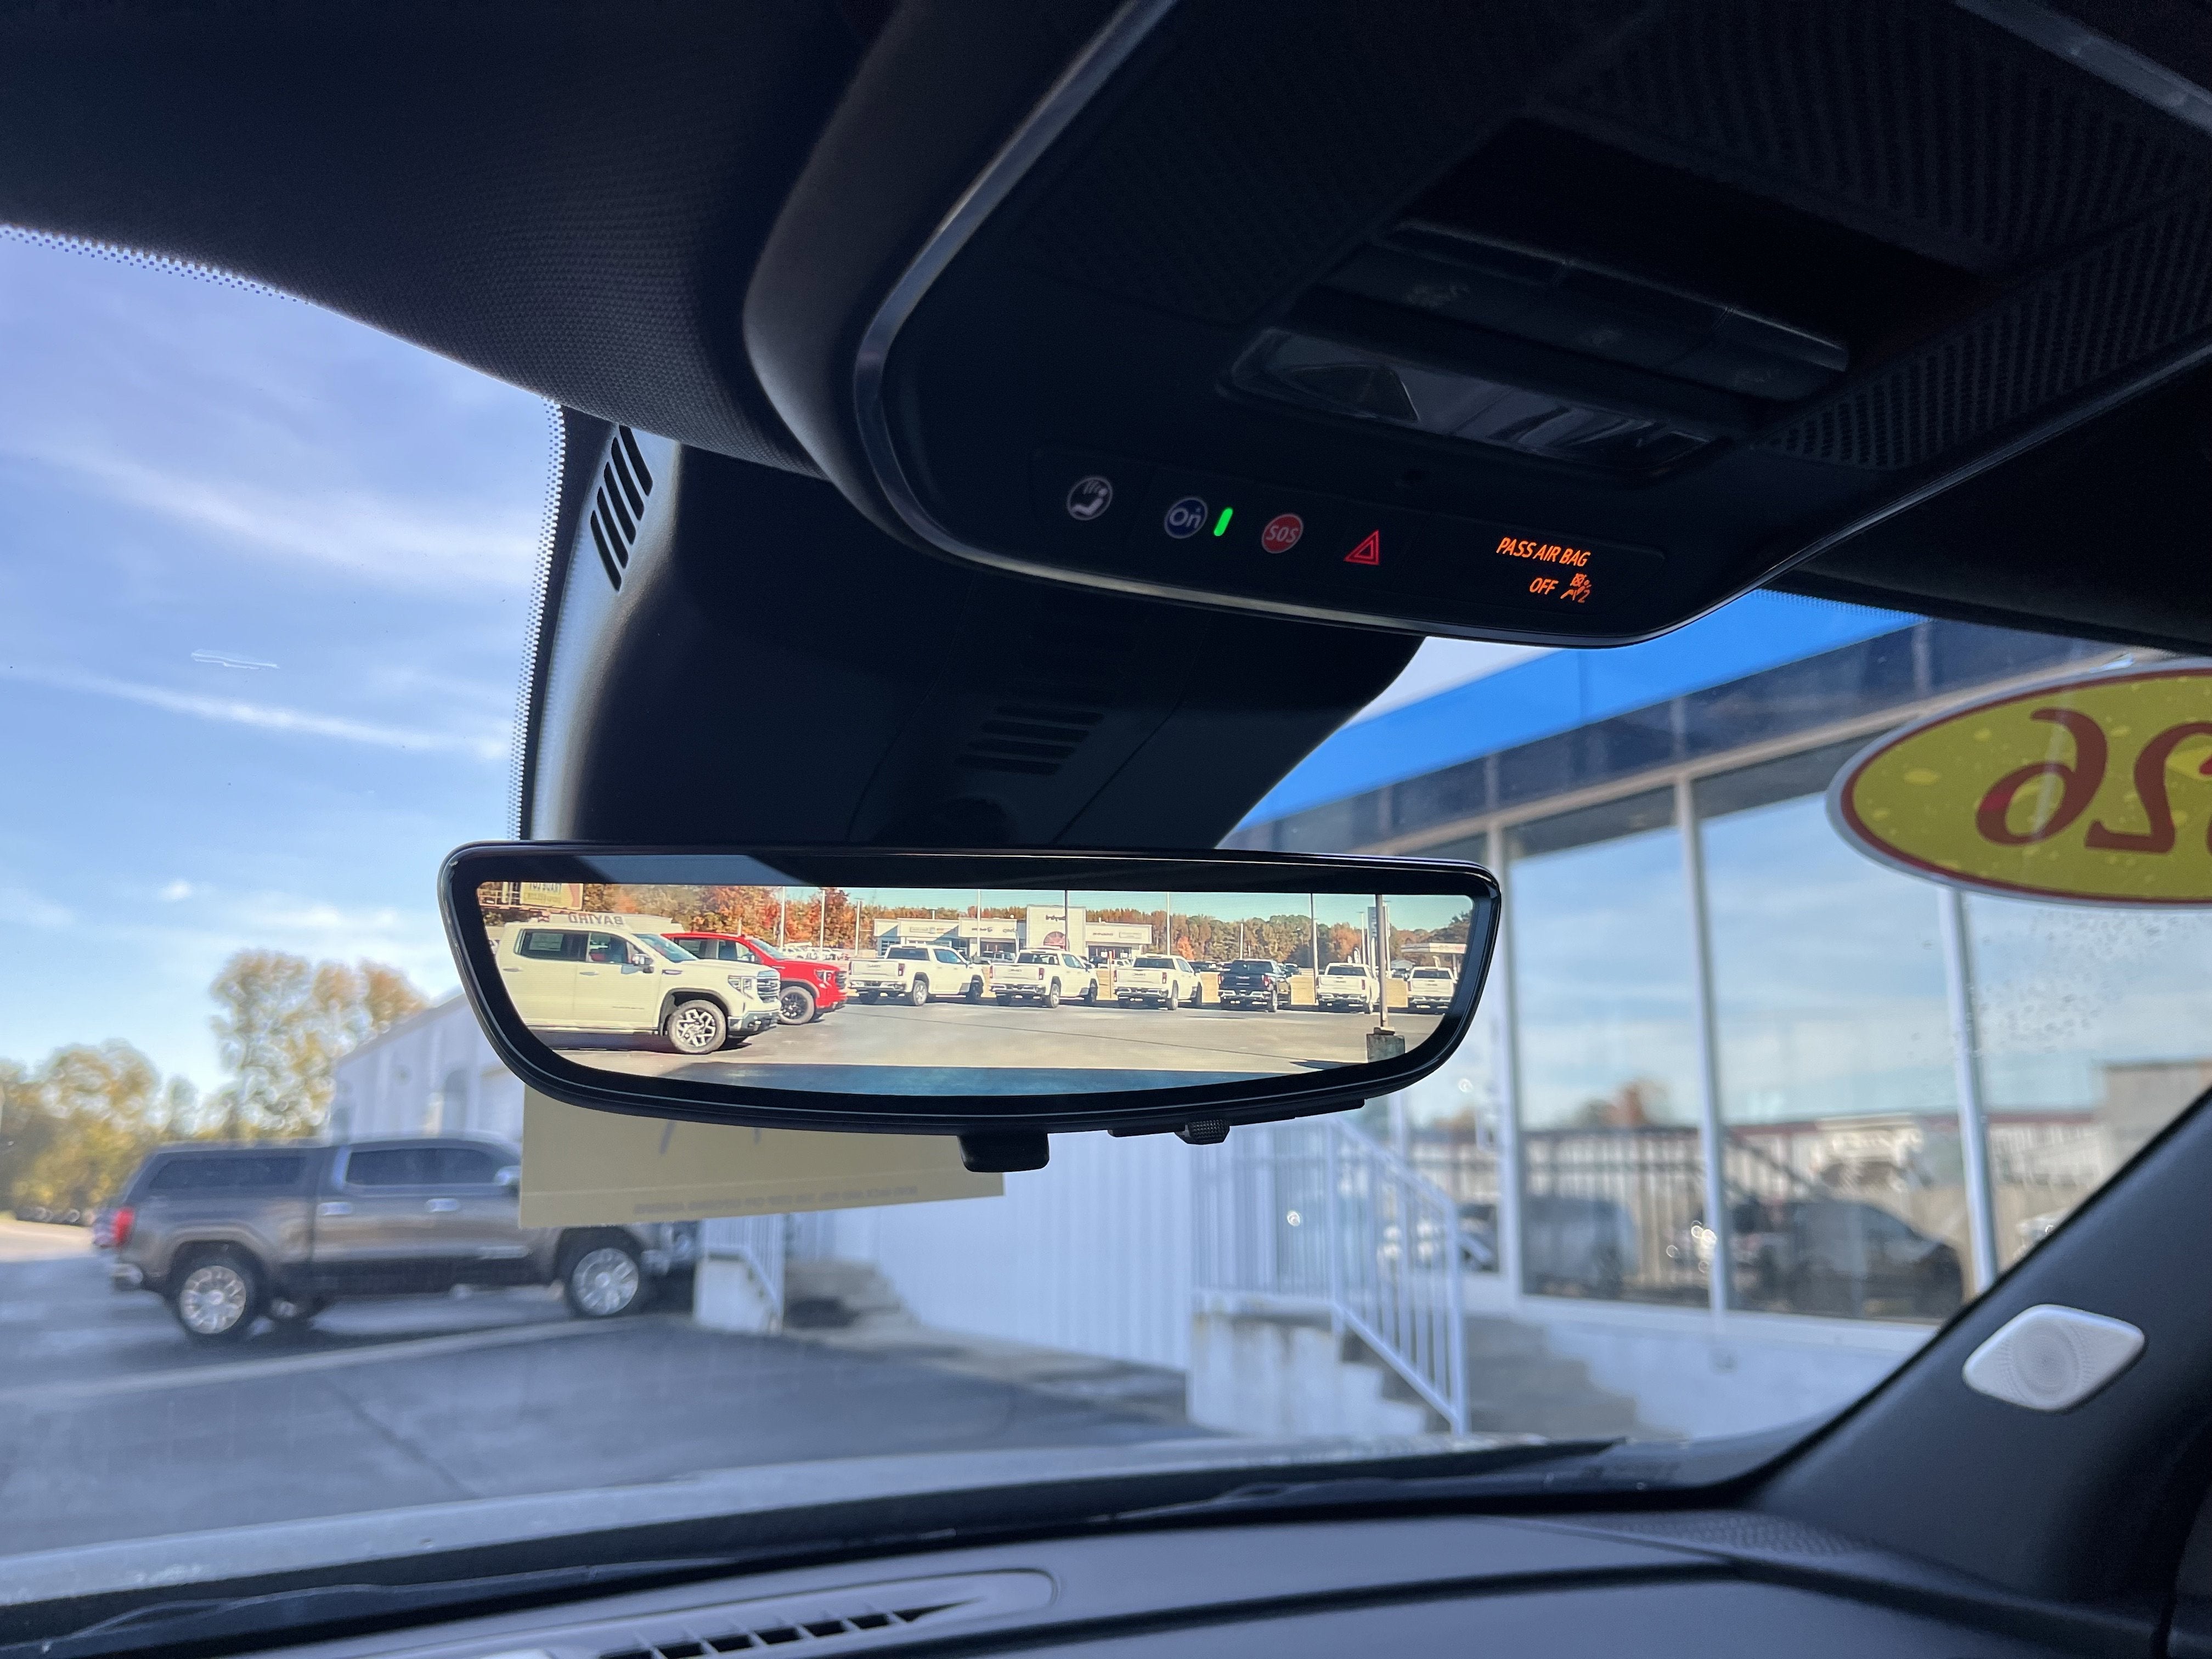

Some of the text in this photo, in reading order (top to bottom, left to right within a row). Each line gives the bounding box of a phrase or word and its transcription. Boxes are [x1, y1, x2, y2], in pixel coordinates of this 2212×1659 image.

[1169, 507, 1202, 529] On
[1266, 524, 1299, 543] SOS
[1496, 537, 1591, 567] PASS AIR BAG
[1529, 577, 1559, 595] OFF
